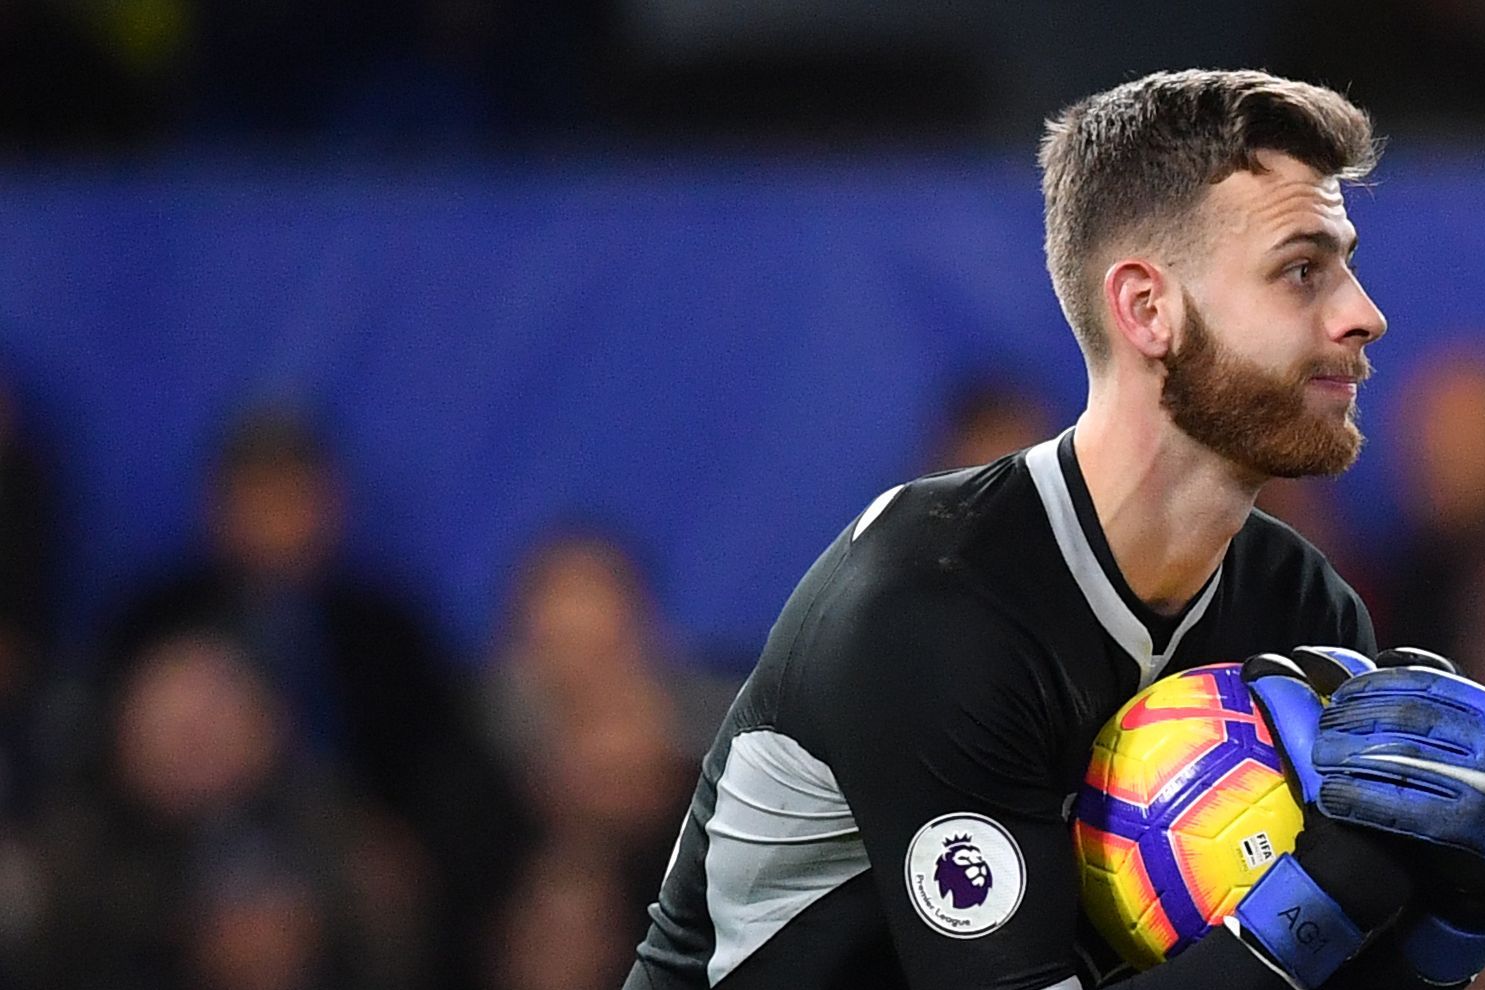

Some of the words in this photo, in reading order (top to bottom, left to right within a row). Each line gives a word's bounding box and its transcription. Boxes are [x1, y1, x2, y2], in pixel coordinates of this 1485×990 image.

[1256, 833, 1272, 860] FIFA
[917, 874, 934, 909] Premier
[935, 908, 972, 928] League
